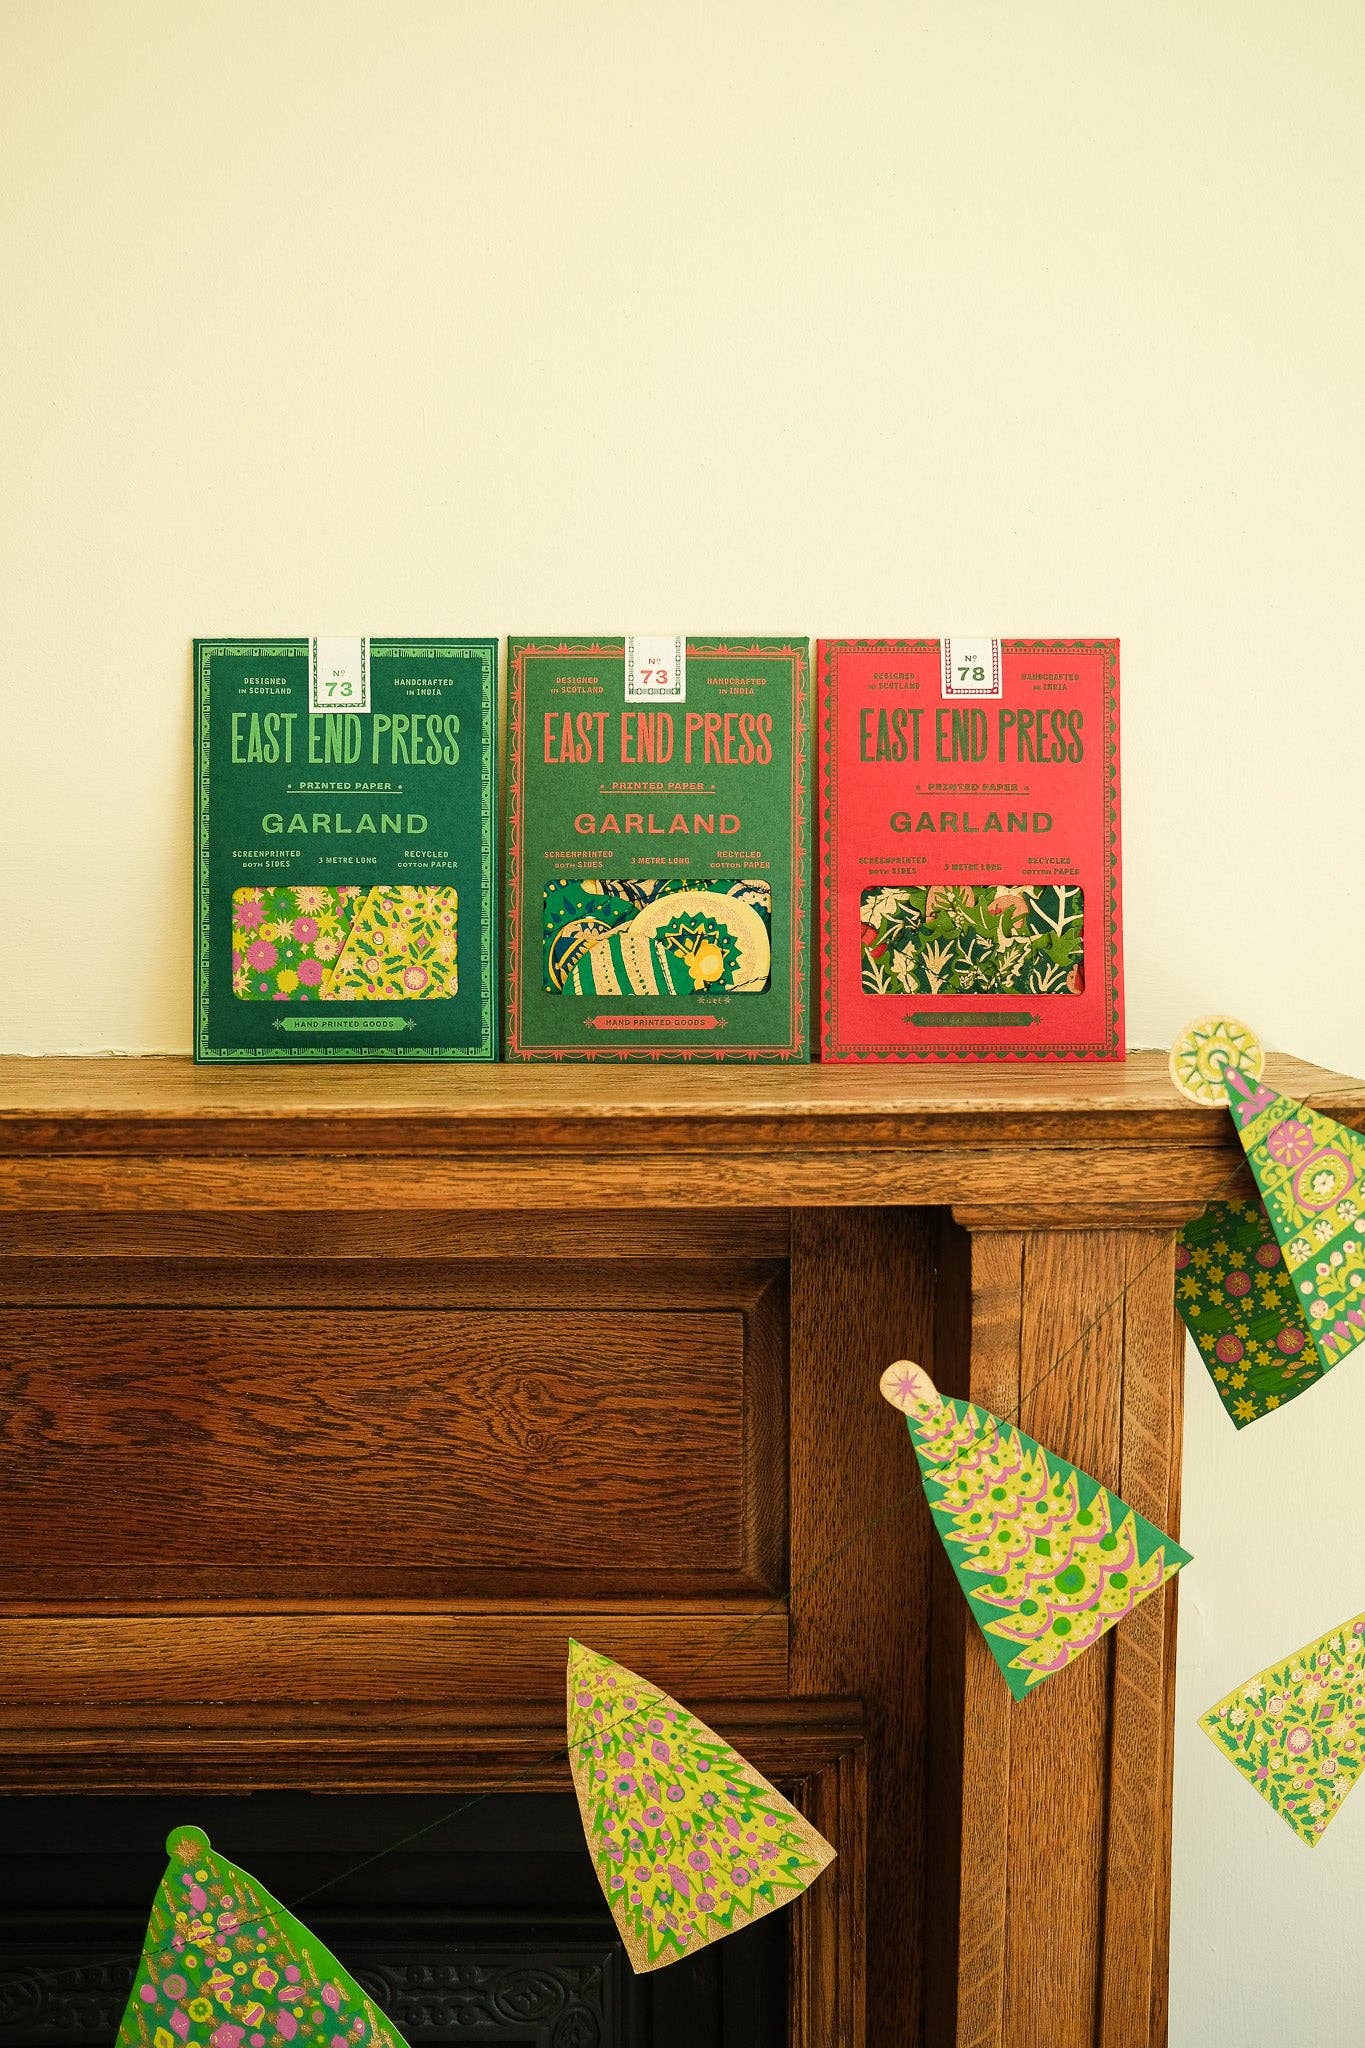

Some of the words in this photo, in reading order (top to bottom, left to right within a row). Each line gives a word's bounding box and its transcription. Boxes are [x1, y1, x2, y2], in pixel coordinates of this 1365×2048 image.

[640, 669, 668, 684] 73
[957, 667, 985, 681] 78
[325, 682, 353, 697] 73
[231, 712, 297, 764] EAST
[309, 713, 362, 764] END
[373, 714, 460, 765] PRESS
[544, 712, 609, 764] EAST
[621, 713, 673, 764] END
[685, 713, 773, 765] PRESS
[860, 708, 927, 762] EAST
[936, 709, 988, 762] END
[999, 709, 1084, 763] PRESS
[300, 782, 351, 790] PRINTED
[355, 782, 392, 790] PAPER
[612, 782, 664, 790] PRINTED
[668, 782, 704, 790] PAPER
[262, 813, 428, 834] GARLAND
[574, 814, 741, 835] GARLAND
[890, 812, 1054, 833] GARLAND
[356, 856, 377, 864] LONG
[544, 850, 613, 858] SCREENPRINTED
[858, 856, 927, 864] SCREENPRINTED
[265, 860, 290, 868] SIDES
